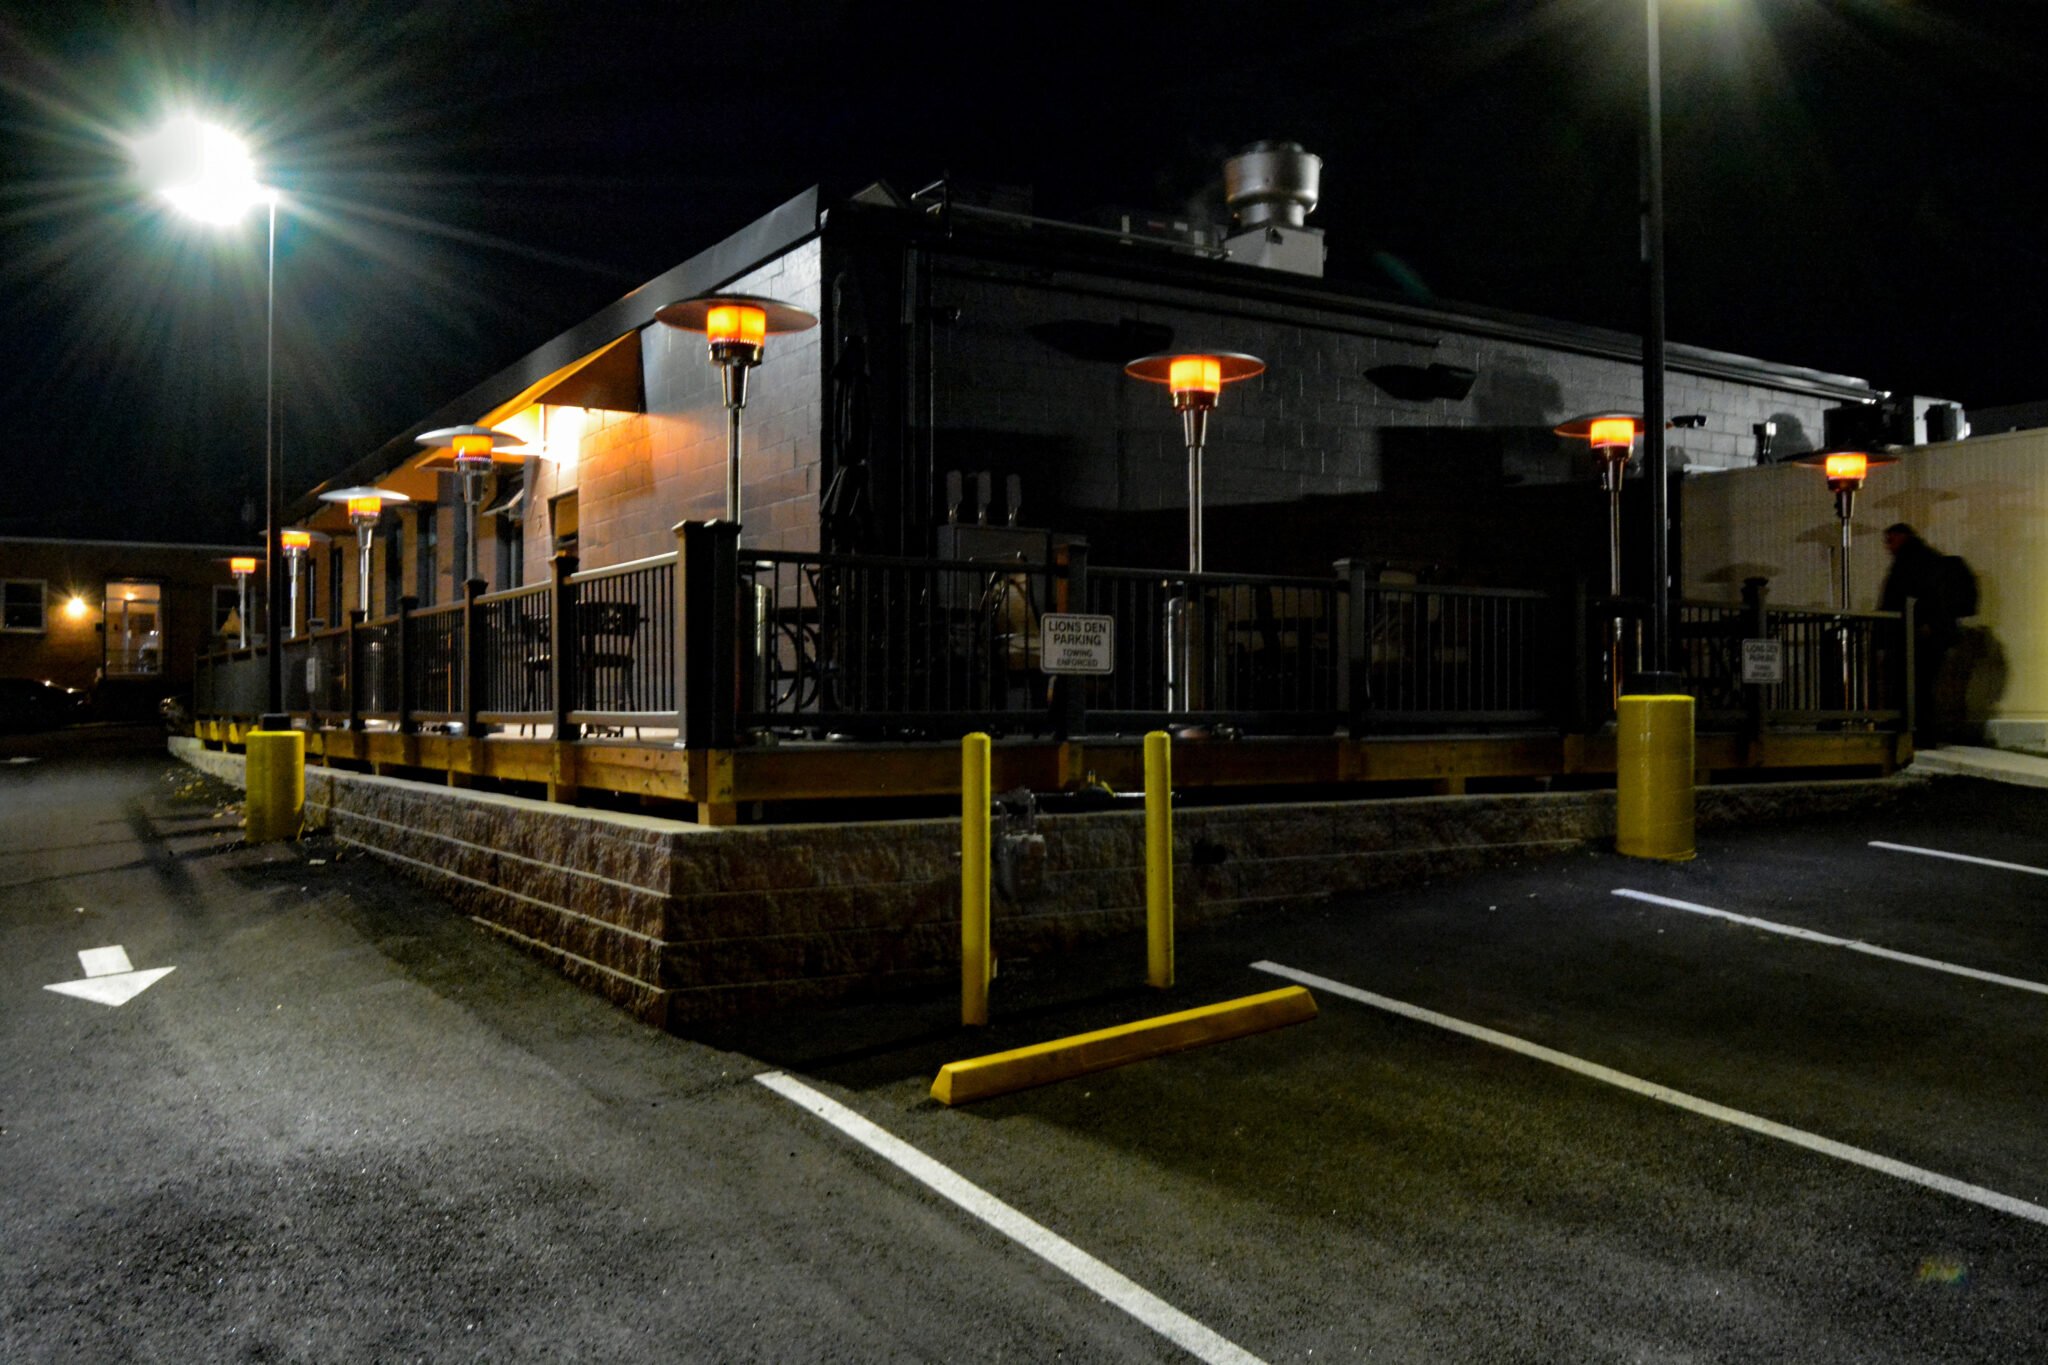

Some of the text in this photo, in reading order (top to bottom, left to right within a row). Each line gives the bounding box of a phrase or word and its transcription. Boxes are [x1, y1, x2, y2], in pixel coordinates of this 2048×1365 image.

[1048, 620, 1107, 633] LIONS DEN
[1053, 633, 1102, 646] PARKING
[1063, 648, 1093, 657] TOWING
